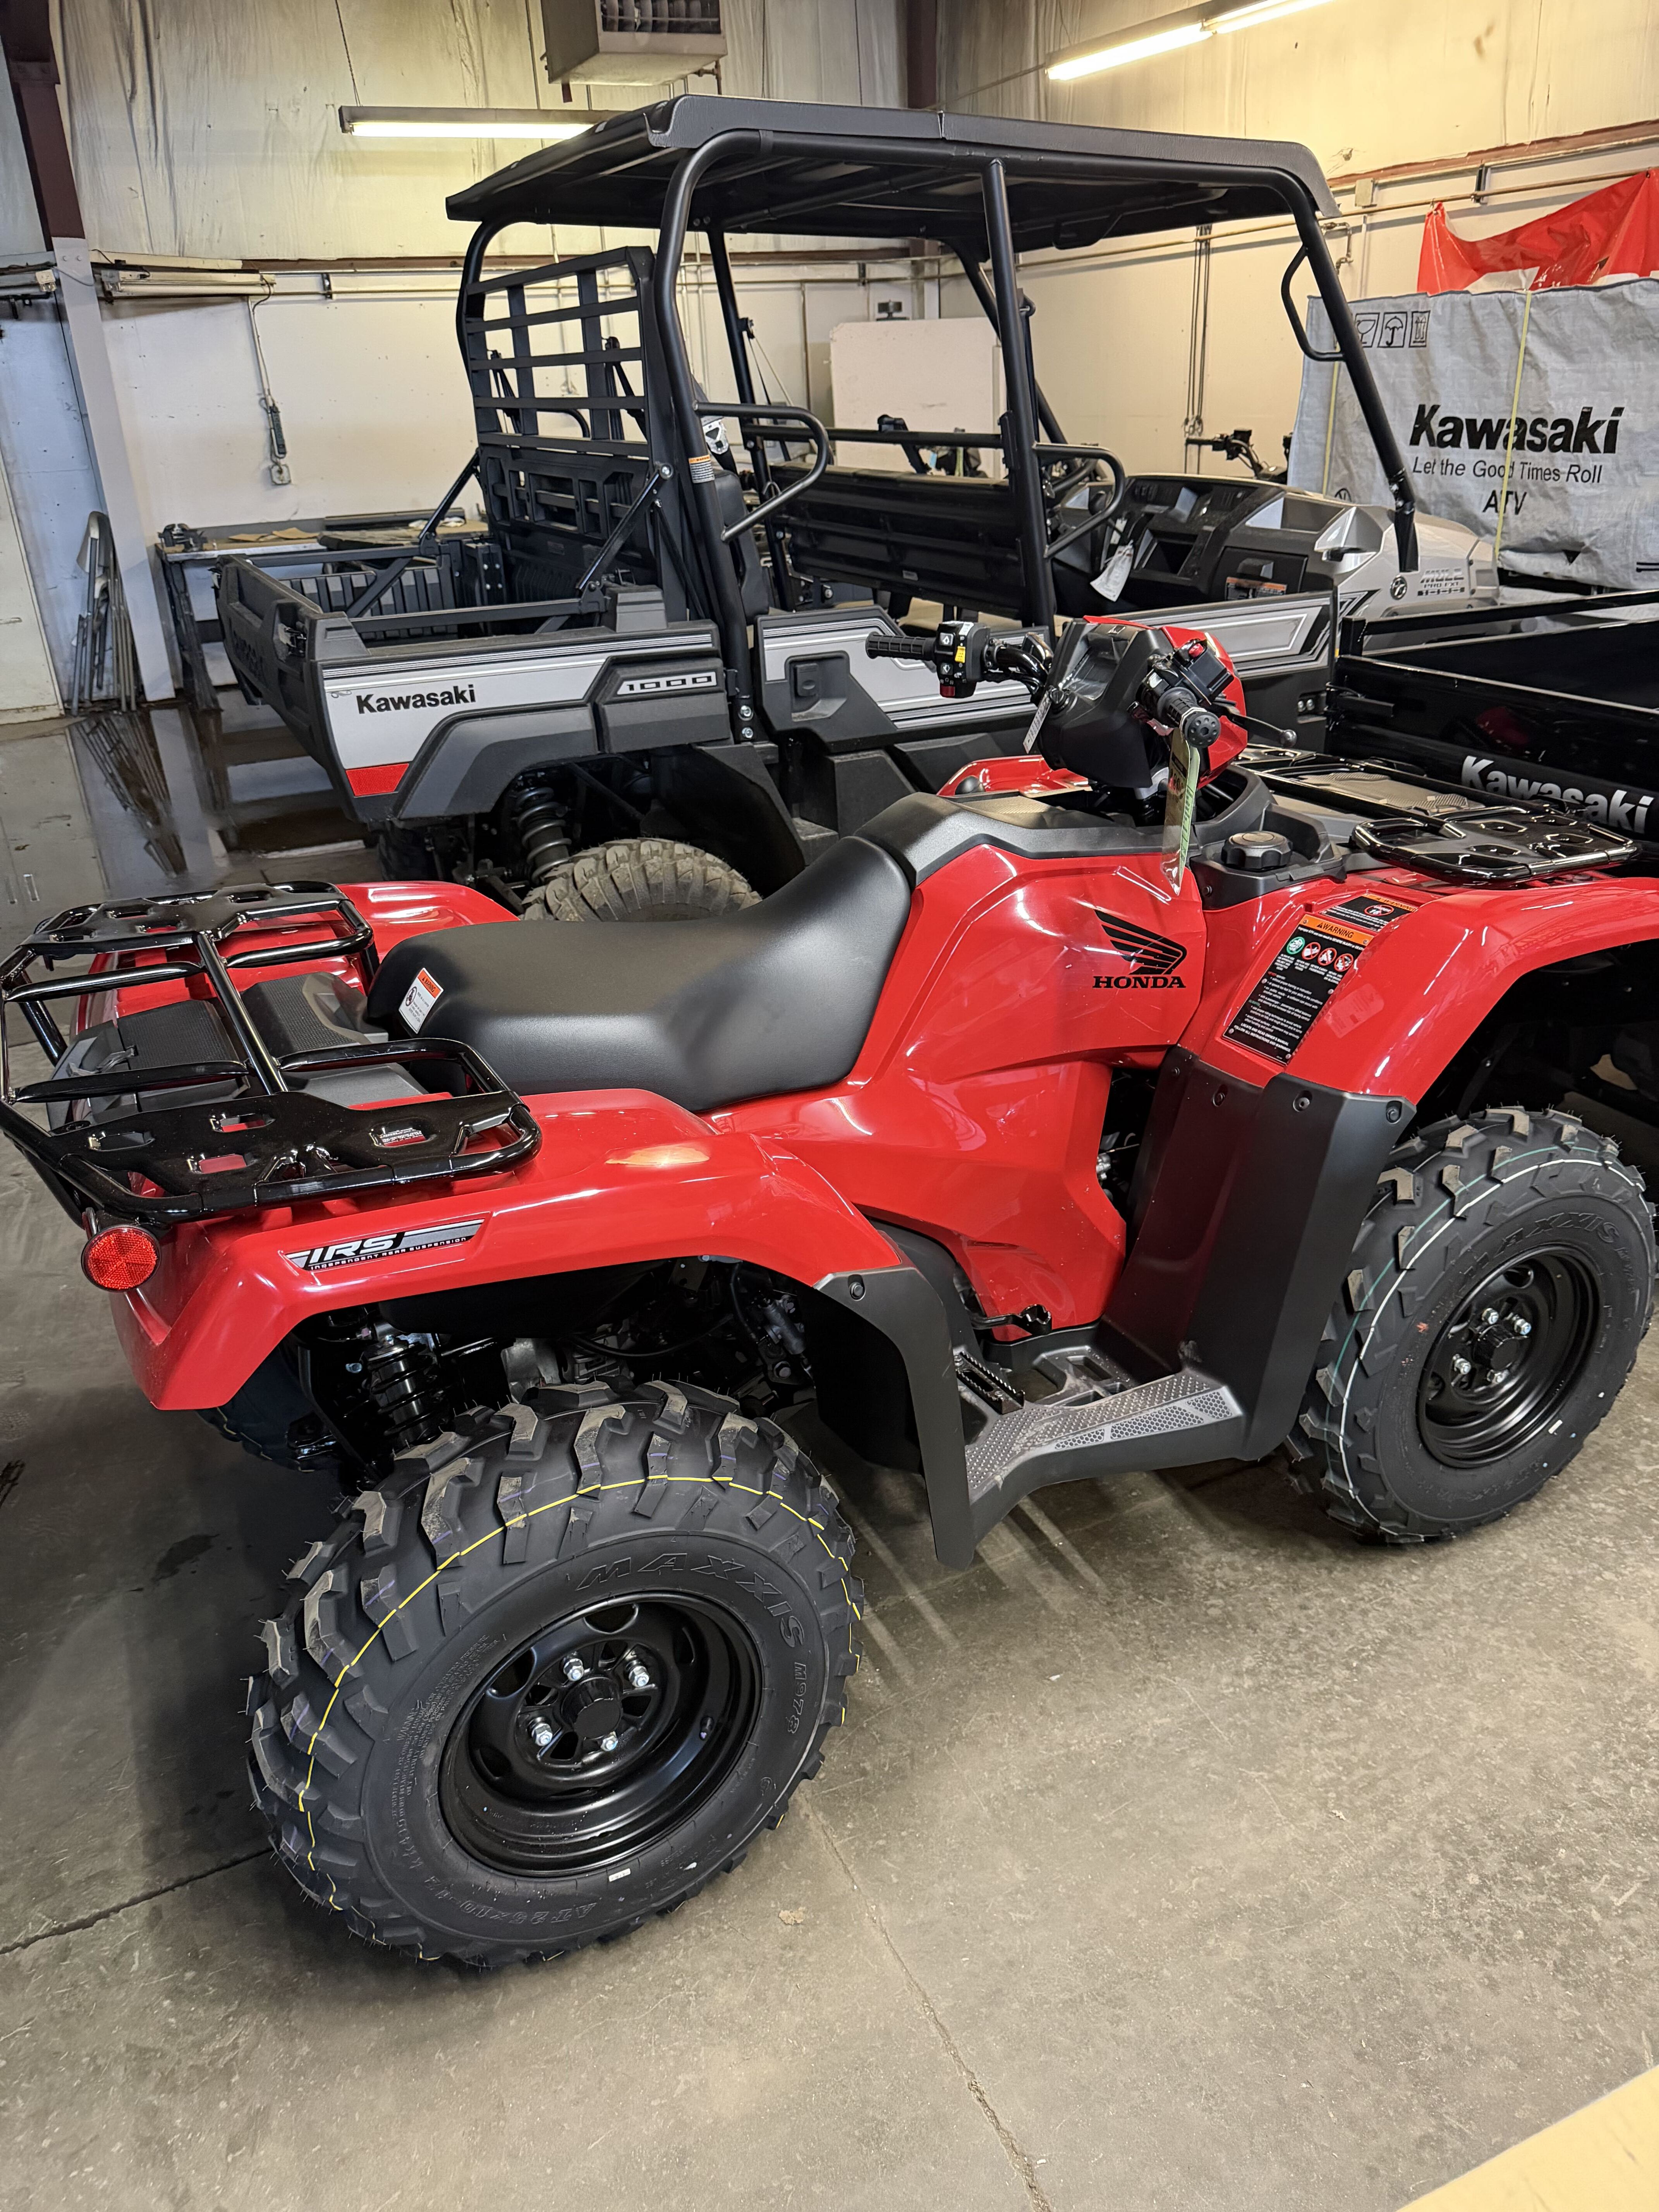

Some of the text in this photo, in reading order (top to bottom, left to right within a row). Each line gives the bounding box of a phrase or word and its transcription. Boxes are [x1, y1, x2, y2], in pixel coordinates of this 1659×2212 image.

[1409, 404, 1625, 454] Kawasaki
[1413, 457, 1602, 484] Let the Good Times Roll
[1482, 489, 1527, 515] ATV
[625, 675, 713, 691] 1000
[356, 684, 477, 714] Kawasaki
[1321, 923, 1355, 938] WARNING
[1092, 975, 1187, 989] HONDA
[309, 1233, 398, 1264] IRS
[311, 1237, 467, 1271] INDEPENDENT REAR SUSPENSION
[575, 1553, 805, 1648] MAXXIS
[788, 1662, 807, 1734] M978
